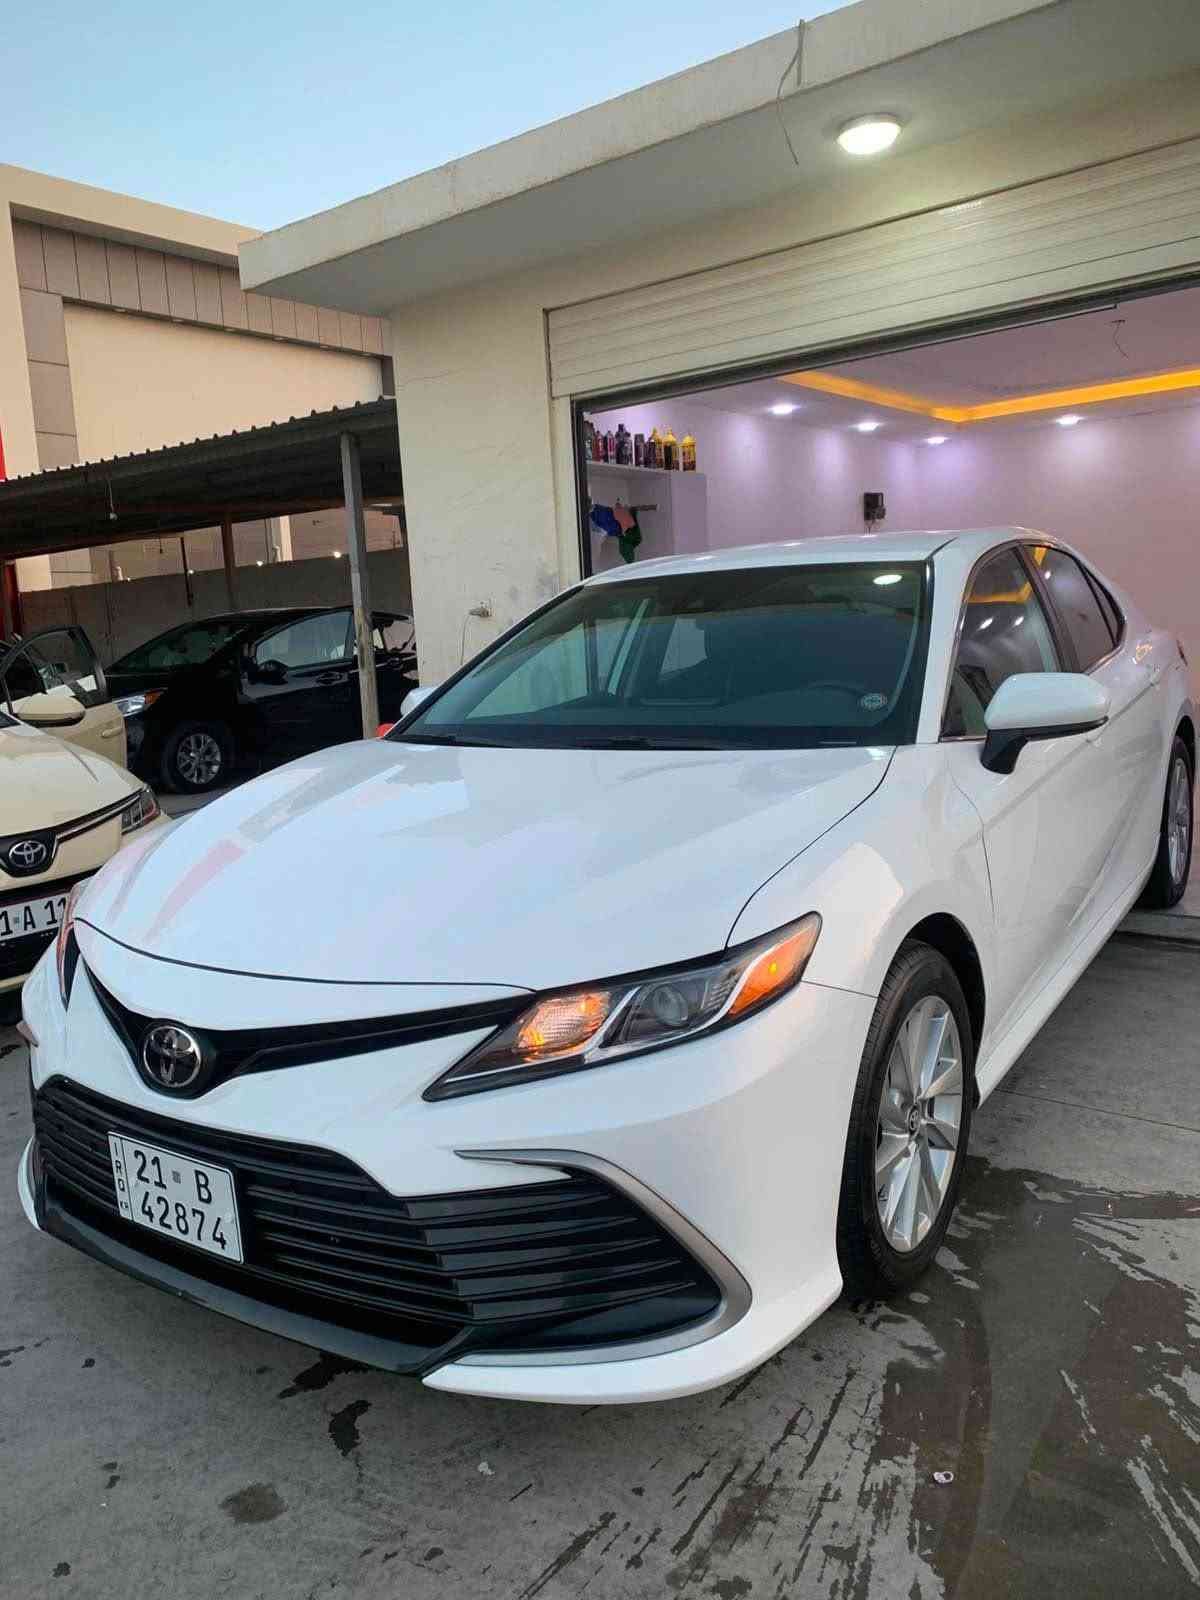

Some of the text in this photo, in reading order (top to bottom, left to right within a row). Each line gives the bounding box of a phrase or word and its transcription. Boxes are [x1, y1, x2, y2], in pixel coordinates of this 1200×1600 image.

[23, 905, 36, 931] A
[134, 1150, 212, 1204] 21 B
[141, 1191, 227, 1250] 42874
